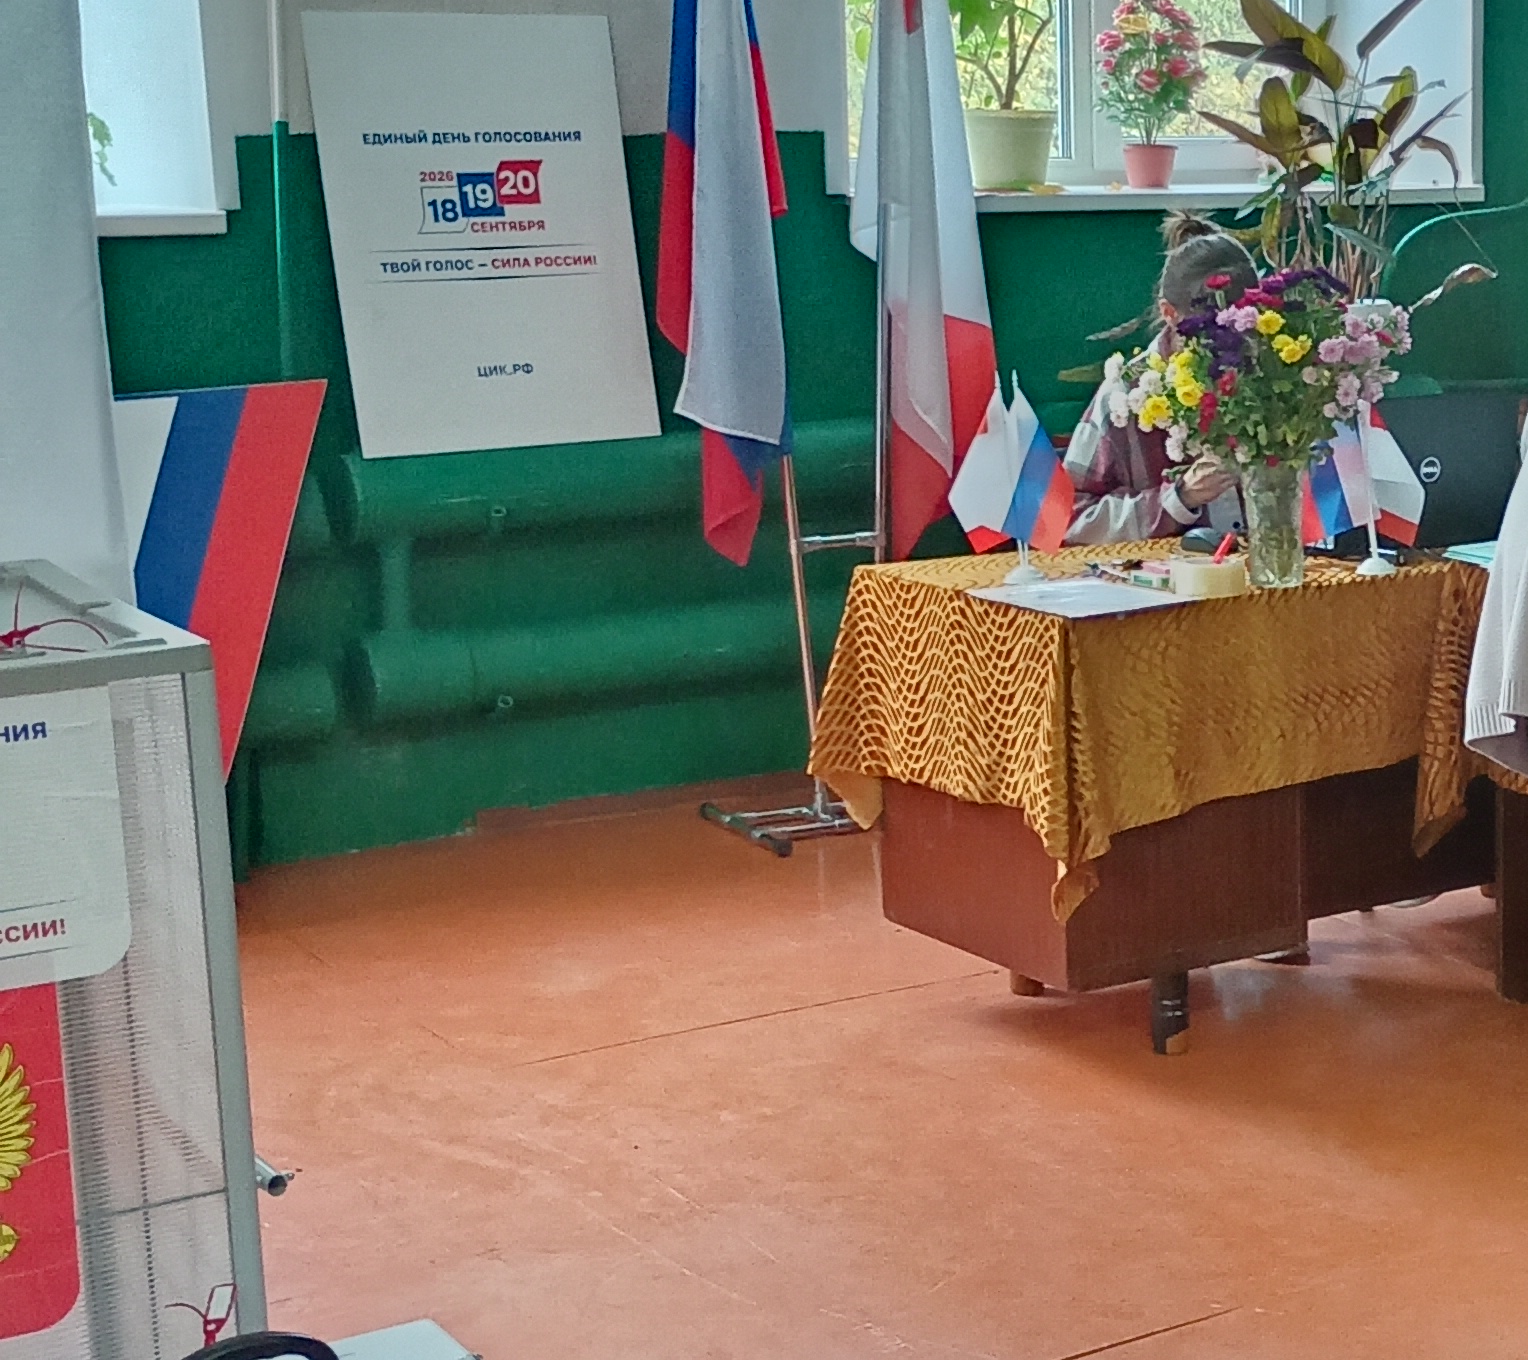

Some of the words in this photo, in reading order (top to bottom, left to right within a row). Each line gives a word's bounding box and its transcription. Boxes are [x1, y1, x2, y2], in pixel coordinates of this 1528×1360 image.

[362, 129, 428, 145] ЕДИНЫЙ
[432, 131, 471, 145] ДЕНЬ
[474, 130, 582, 143] ГОЛОСОВАНИЯ
[419, 171, 454, 182] 2026
[427, 199, 459, 223] 18
[462, 183, 494, 210] 19
[498, 170, 536, 195] 20
[470, 220, 546, 233] СЕНТЯБРЯ
[380, 259, 422, 274] ТВОЙ
[425, 259, 474, 272] ГОЛОС
[491, 257, 530, 270] СИЛА
[534, 254, 597, 268] РОССИИ!
[477, 363, 534, 378] ЦИК.РФ
[0, 918, 66, 944] СИИ!
